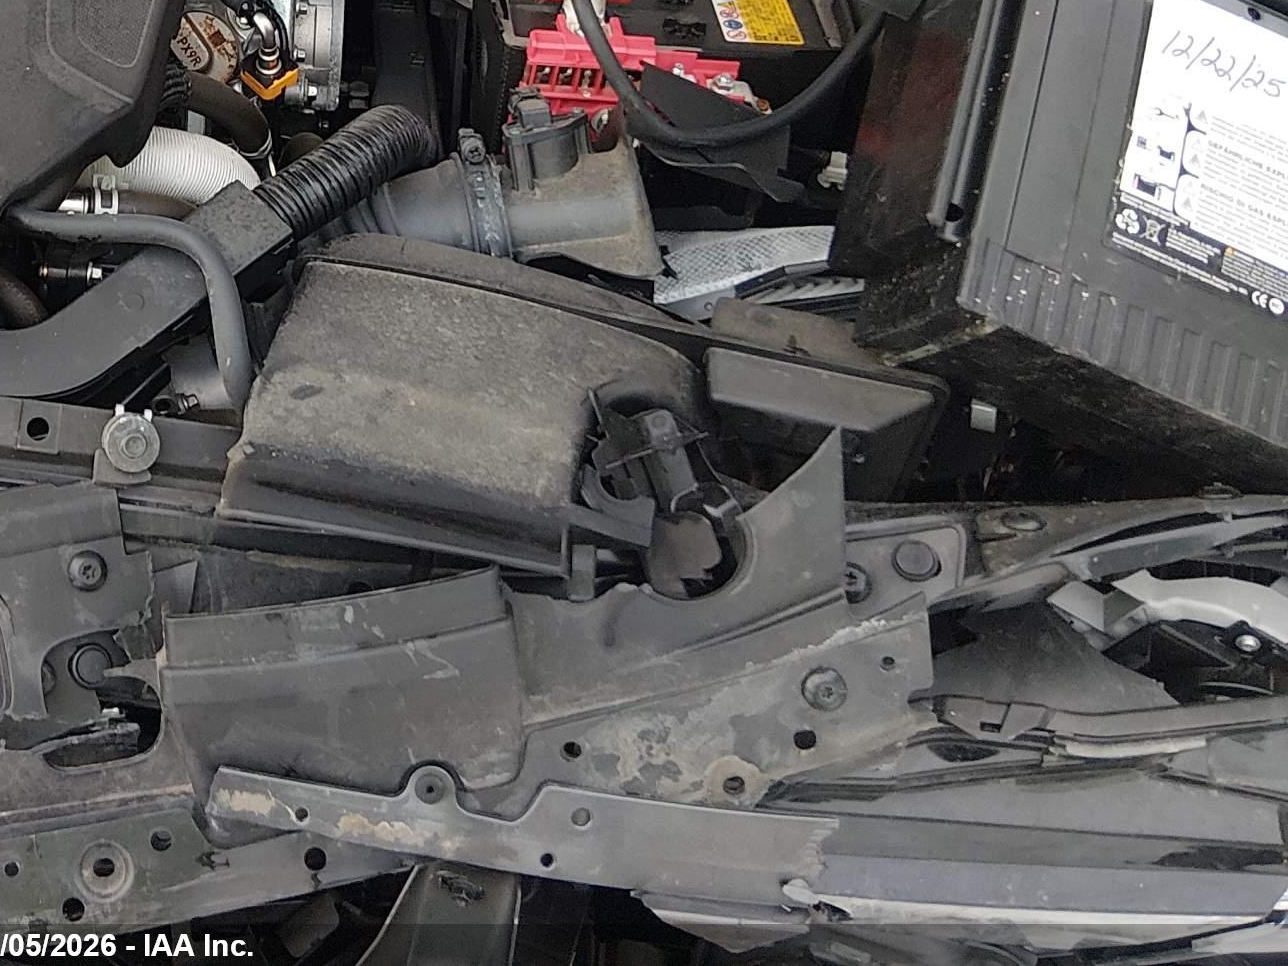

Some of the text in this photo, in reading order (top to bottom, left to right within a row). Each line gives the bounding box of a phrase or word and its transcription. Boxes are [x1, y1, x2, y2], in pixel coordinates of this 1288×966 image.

[1161, 30, 1287, 97] 12/22/25
[1247, 202, 1264, 217] GAS
[1266, 212, 1288, 227] ESPL
